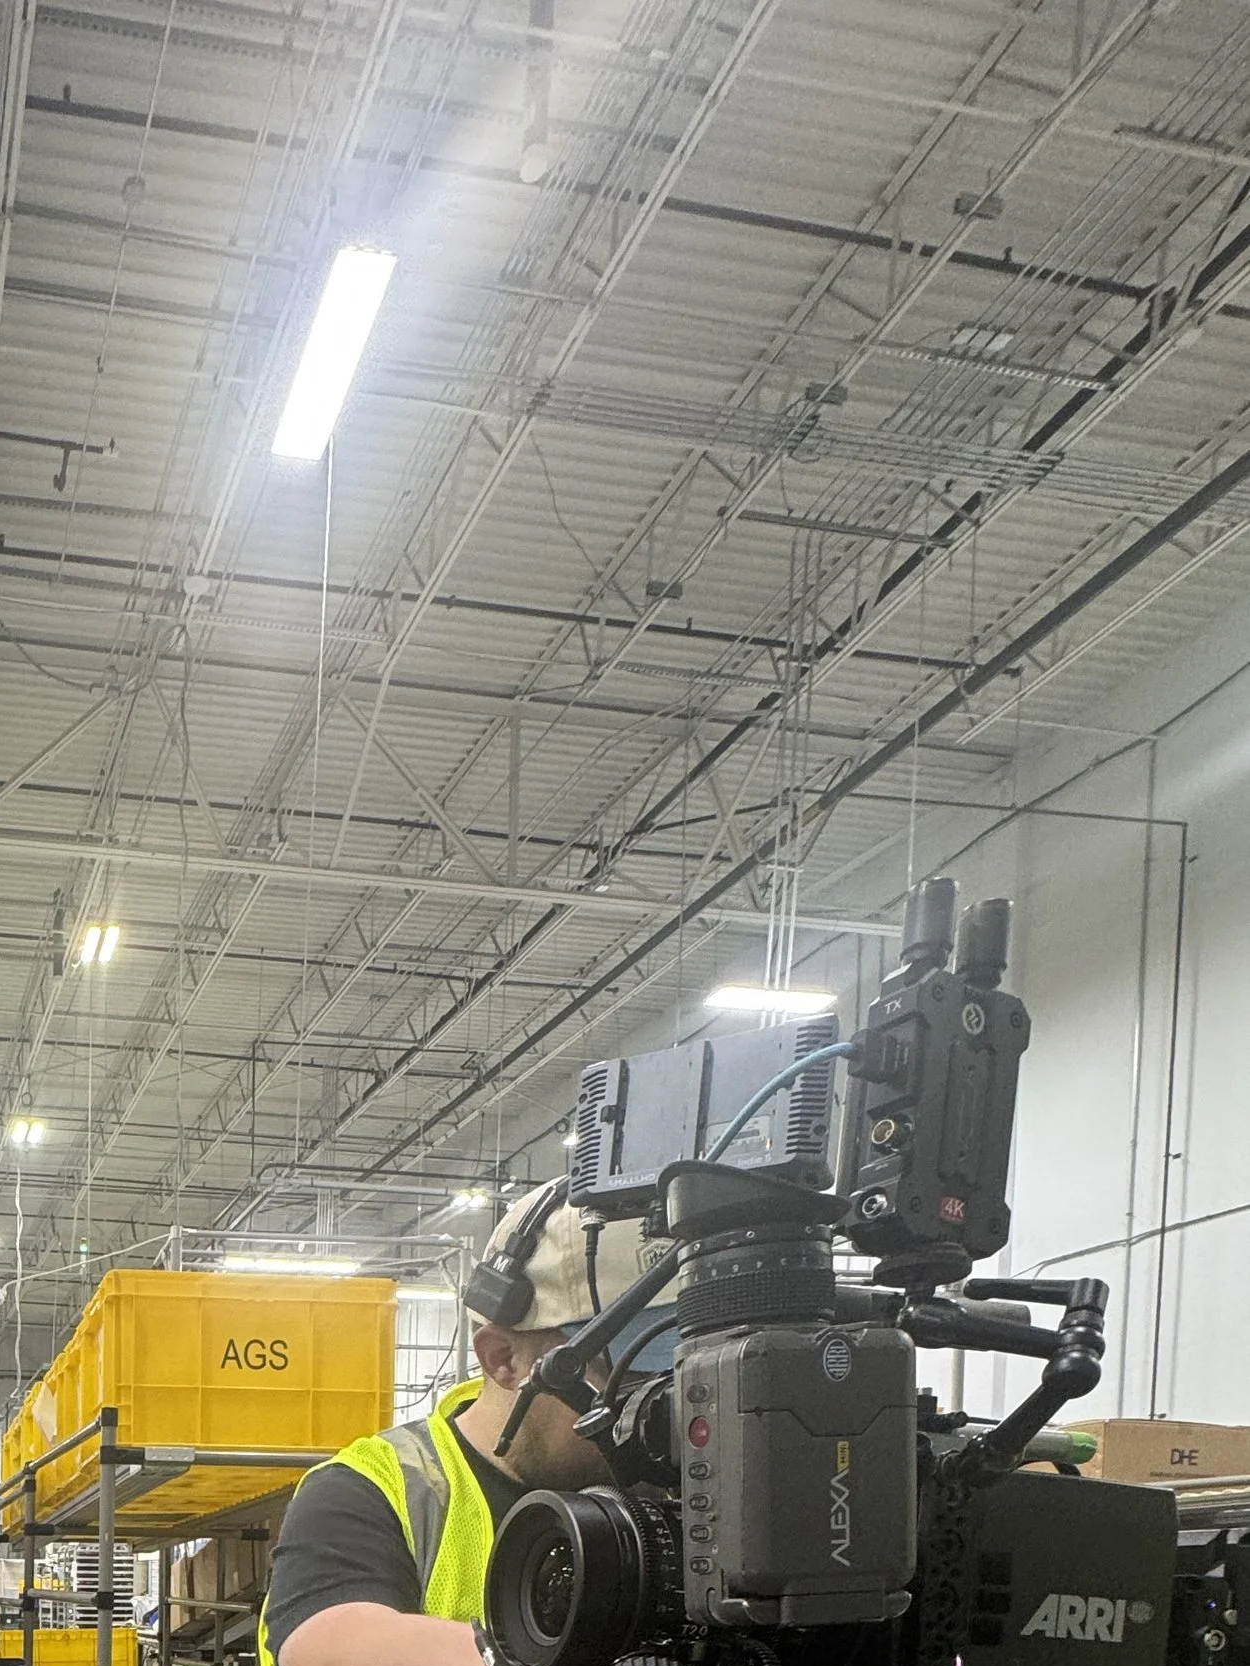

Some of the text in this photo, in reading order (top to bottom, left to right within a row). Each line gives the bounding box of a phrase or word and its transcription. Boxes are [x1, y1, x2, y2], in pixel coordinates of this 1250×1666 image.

[885, 998, 902, 1014] TX
[944, 1199, 966, 1218] 4K
[220, 1338, 290, 1372] AGS
[1170, 1448, 1199, 1466] DHE
[830, 1469, 850, 1567] ALEXA
[1020, 1593, 1127, 1643] ARRI
